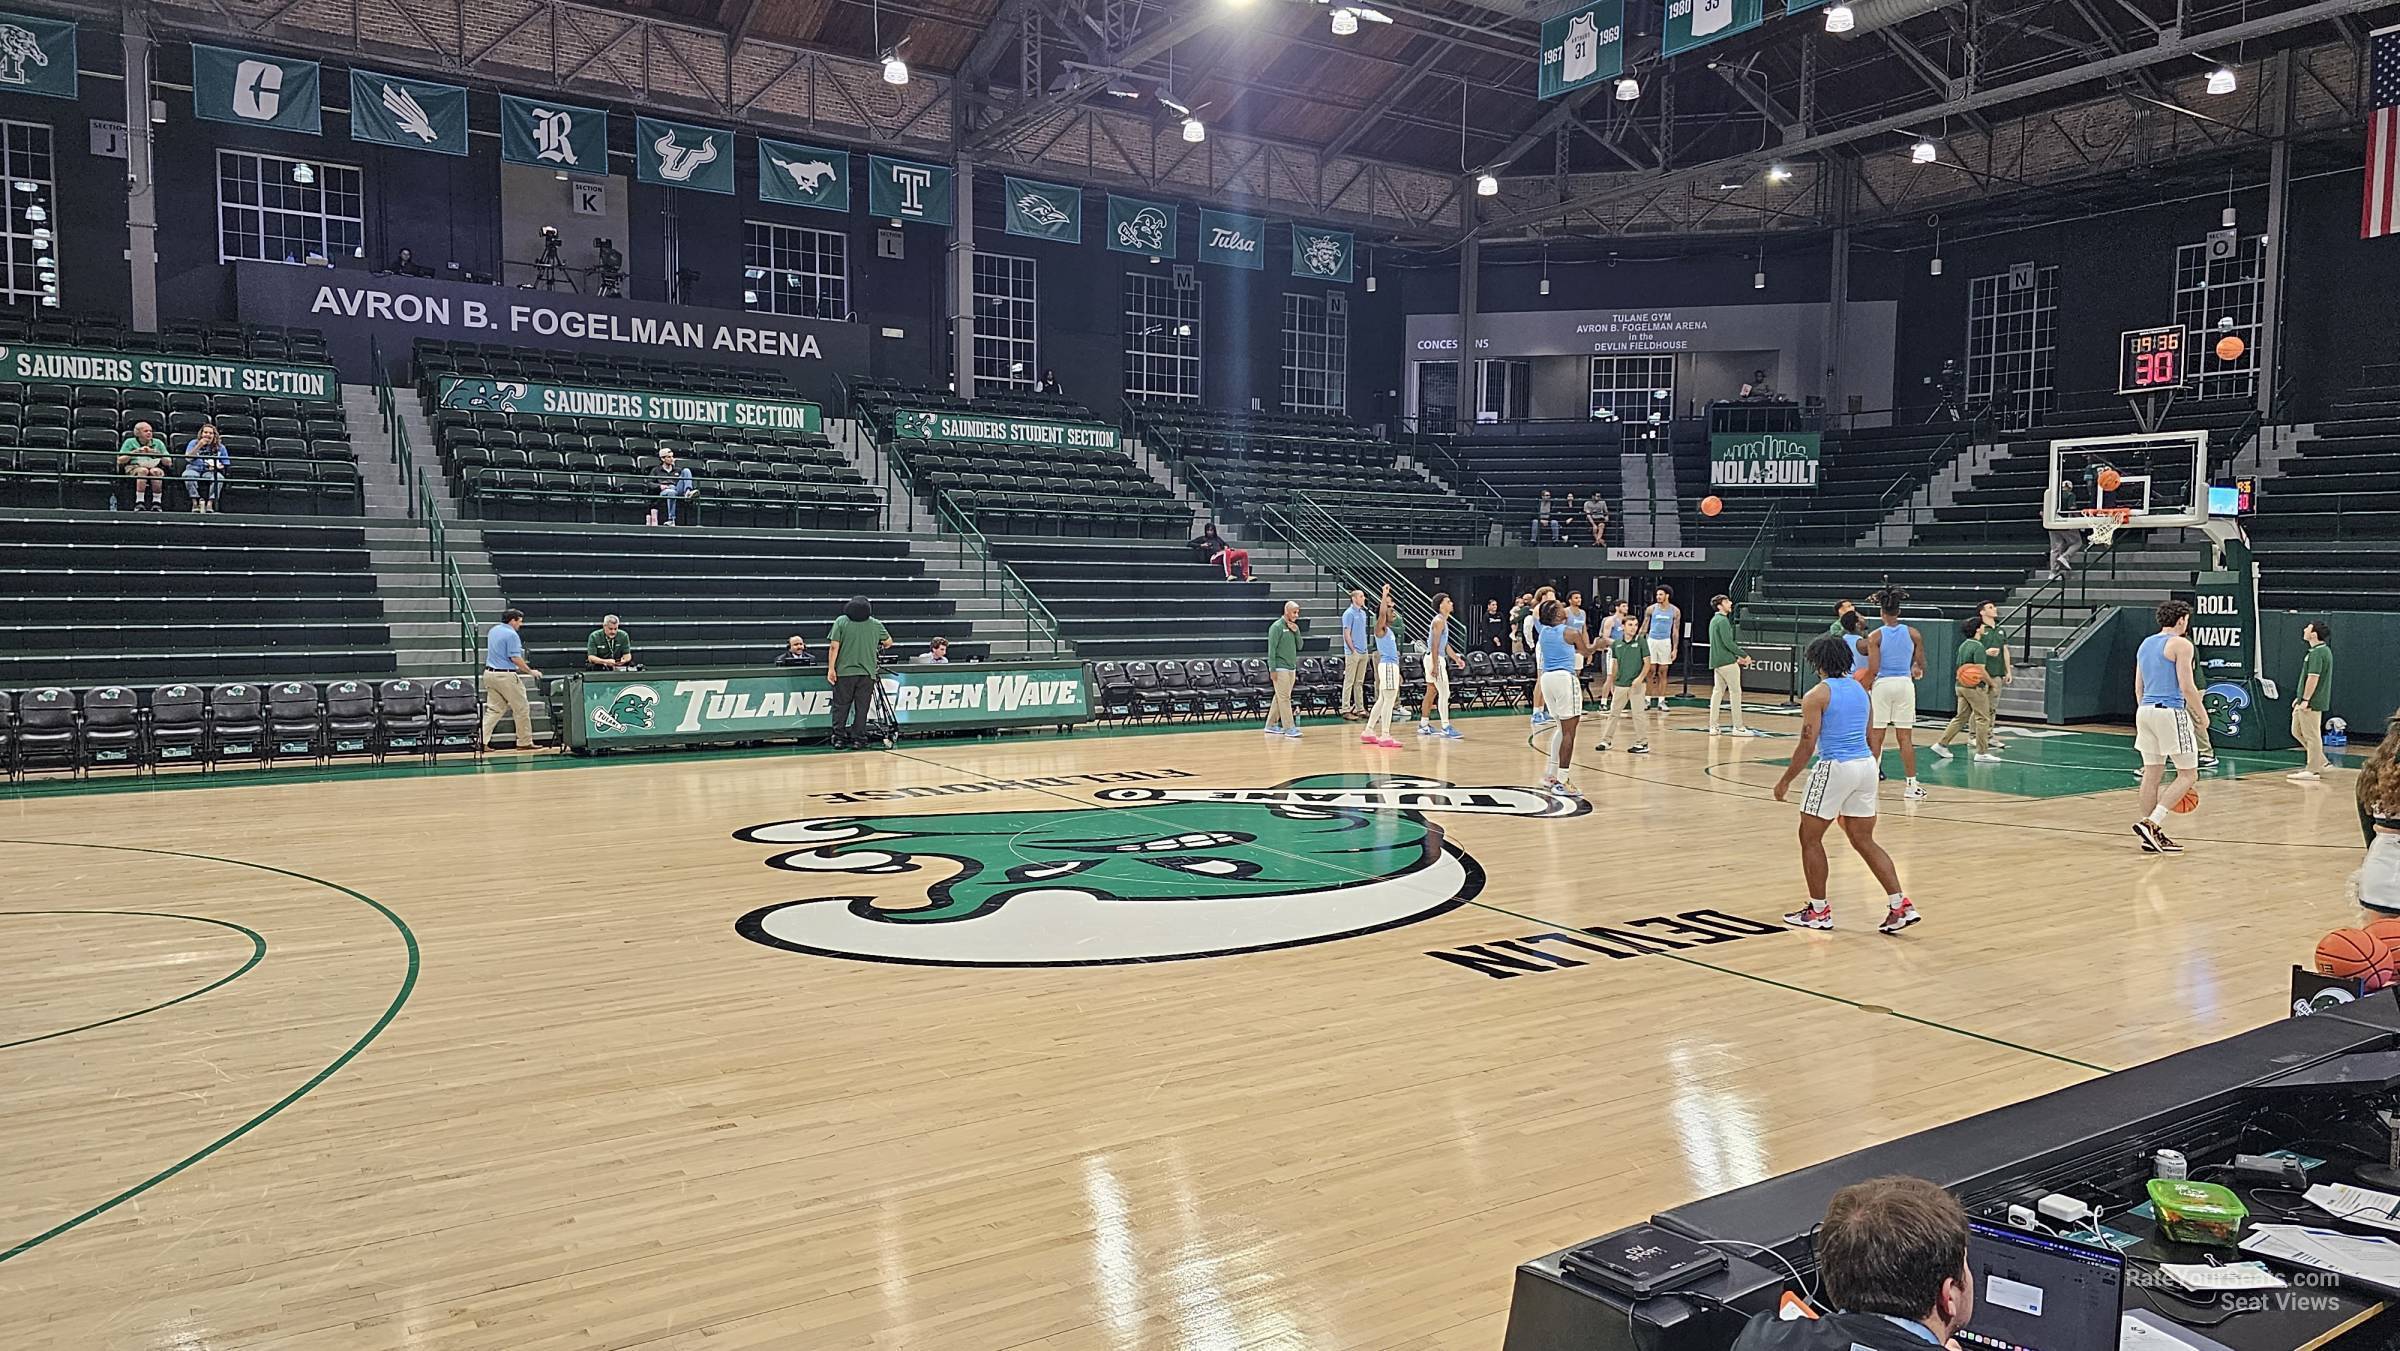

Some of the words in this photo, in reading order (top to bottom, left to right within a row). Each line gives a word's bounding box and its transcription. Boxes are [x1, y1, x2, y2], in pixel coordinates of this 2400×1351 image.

[1668, 0, 1691, 20] 1980
[1599, 25, 1620, 46] 1969
[1543, 46, 1563, 66] 1967
[1575, 41, 1586, 59] 31
[106, 134, 115, 152] J
[575, 183, 603, 193] SECTION
[582, 193, 597, 212] K
[887, 239, 896, 255] L
[1209, 228, 1256, 252] Tulsa
[2213, 240, 2228, 256] O
[1177, 272, 1191, 288] M
[2015, 271, 2027, 288] N
[1331, 299, 1341, 312] N
[311, 286, 449, 326] AVRON
[462, 301, 498, 330] B.
[510, 305, 704, 350] FOGELMAN
[712, 325, 823, 359] ARENA
[1576, 324, 1609, 333] AVRON
[1610, 323, 1620, 332] B.
[1622, 322, 1673, 332] FOGELMAN
[1675, 321, 1708, 330] ARENA
[1612, 314, 1649, 323] TULANE
[1651, 312, 1672, 321] GYM
[1594, 342, 1628, 351] DEVLIN
[1629, 340, 1688, 350] FIELDHOUSE
[1628, 333, 1637, 341] in
[1639, 332, 1654, 341] the
[2131, 333, 2180, 354] 19:36
[16, 353, 133, 382] SAUNDERS
[140, 361, 236, 389] STUDENT
[242, 368, 325, 396] SECTION
[2135, 351, 2173, 385] 30
[543, 389, 643, 417] SAUNDERS
[649, 397, 730, 423] STUDENT
[735, 403, 805, 429] SECTION
[941, 419, 1007, 440] SAUNDERS
[1010, 425, 1064, 444] STUDENT
[1067, 428, 1114, 448] SECTION
[1711, 460, 1762, 484] NOLA
[1764, 460, 1819, 484] BUILT
[1403, 548, 1430, 557] FRERET
[1431, 548, 1455, 558] STREET
[1616, 550, 1664, 559] NEWCOMB
[1667, 549, 1695, 558] PLACE
[2196, 595, 2238, 615] ROLL
[2192, 627, 2241, 647] WAVE
[673, 679, 833, 732] TULANE
[867, 675, 985, 721] GREEN
[986, 674, 1079, 713] WAVE
[806, 768, 1203, 804] FIELDHOUSE
[1207, 791, 1518, 809] TULANE
[1423, 908, 1791, 980] DEVLIN
